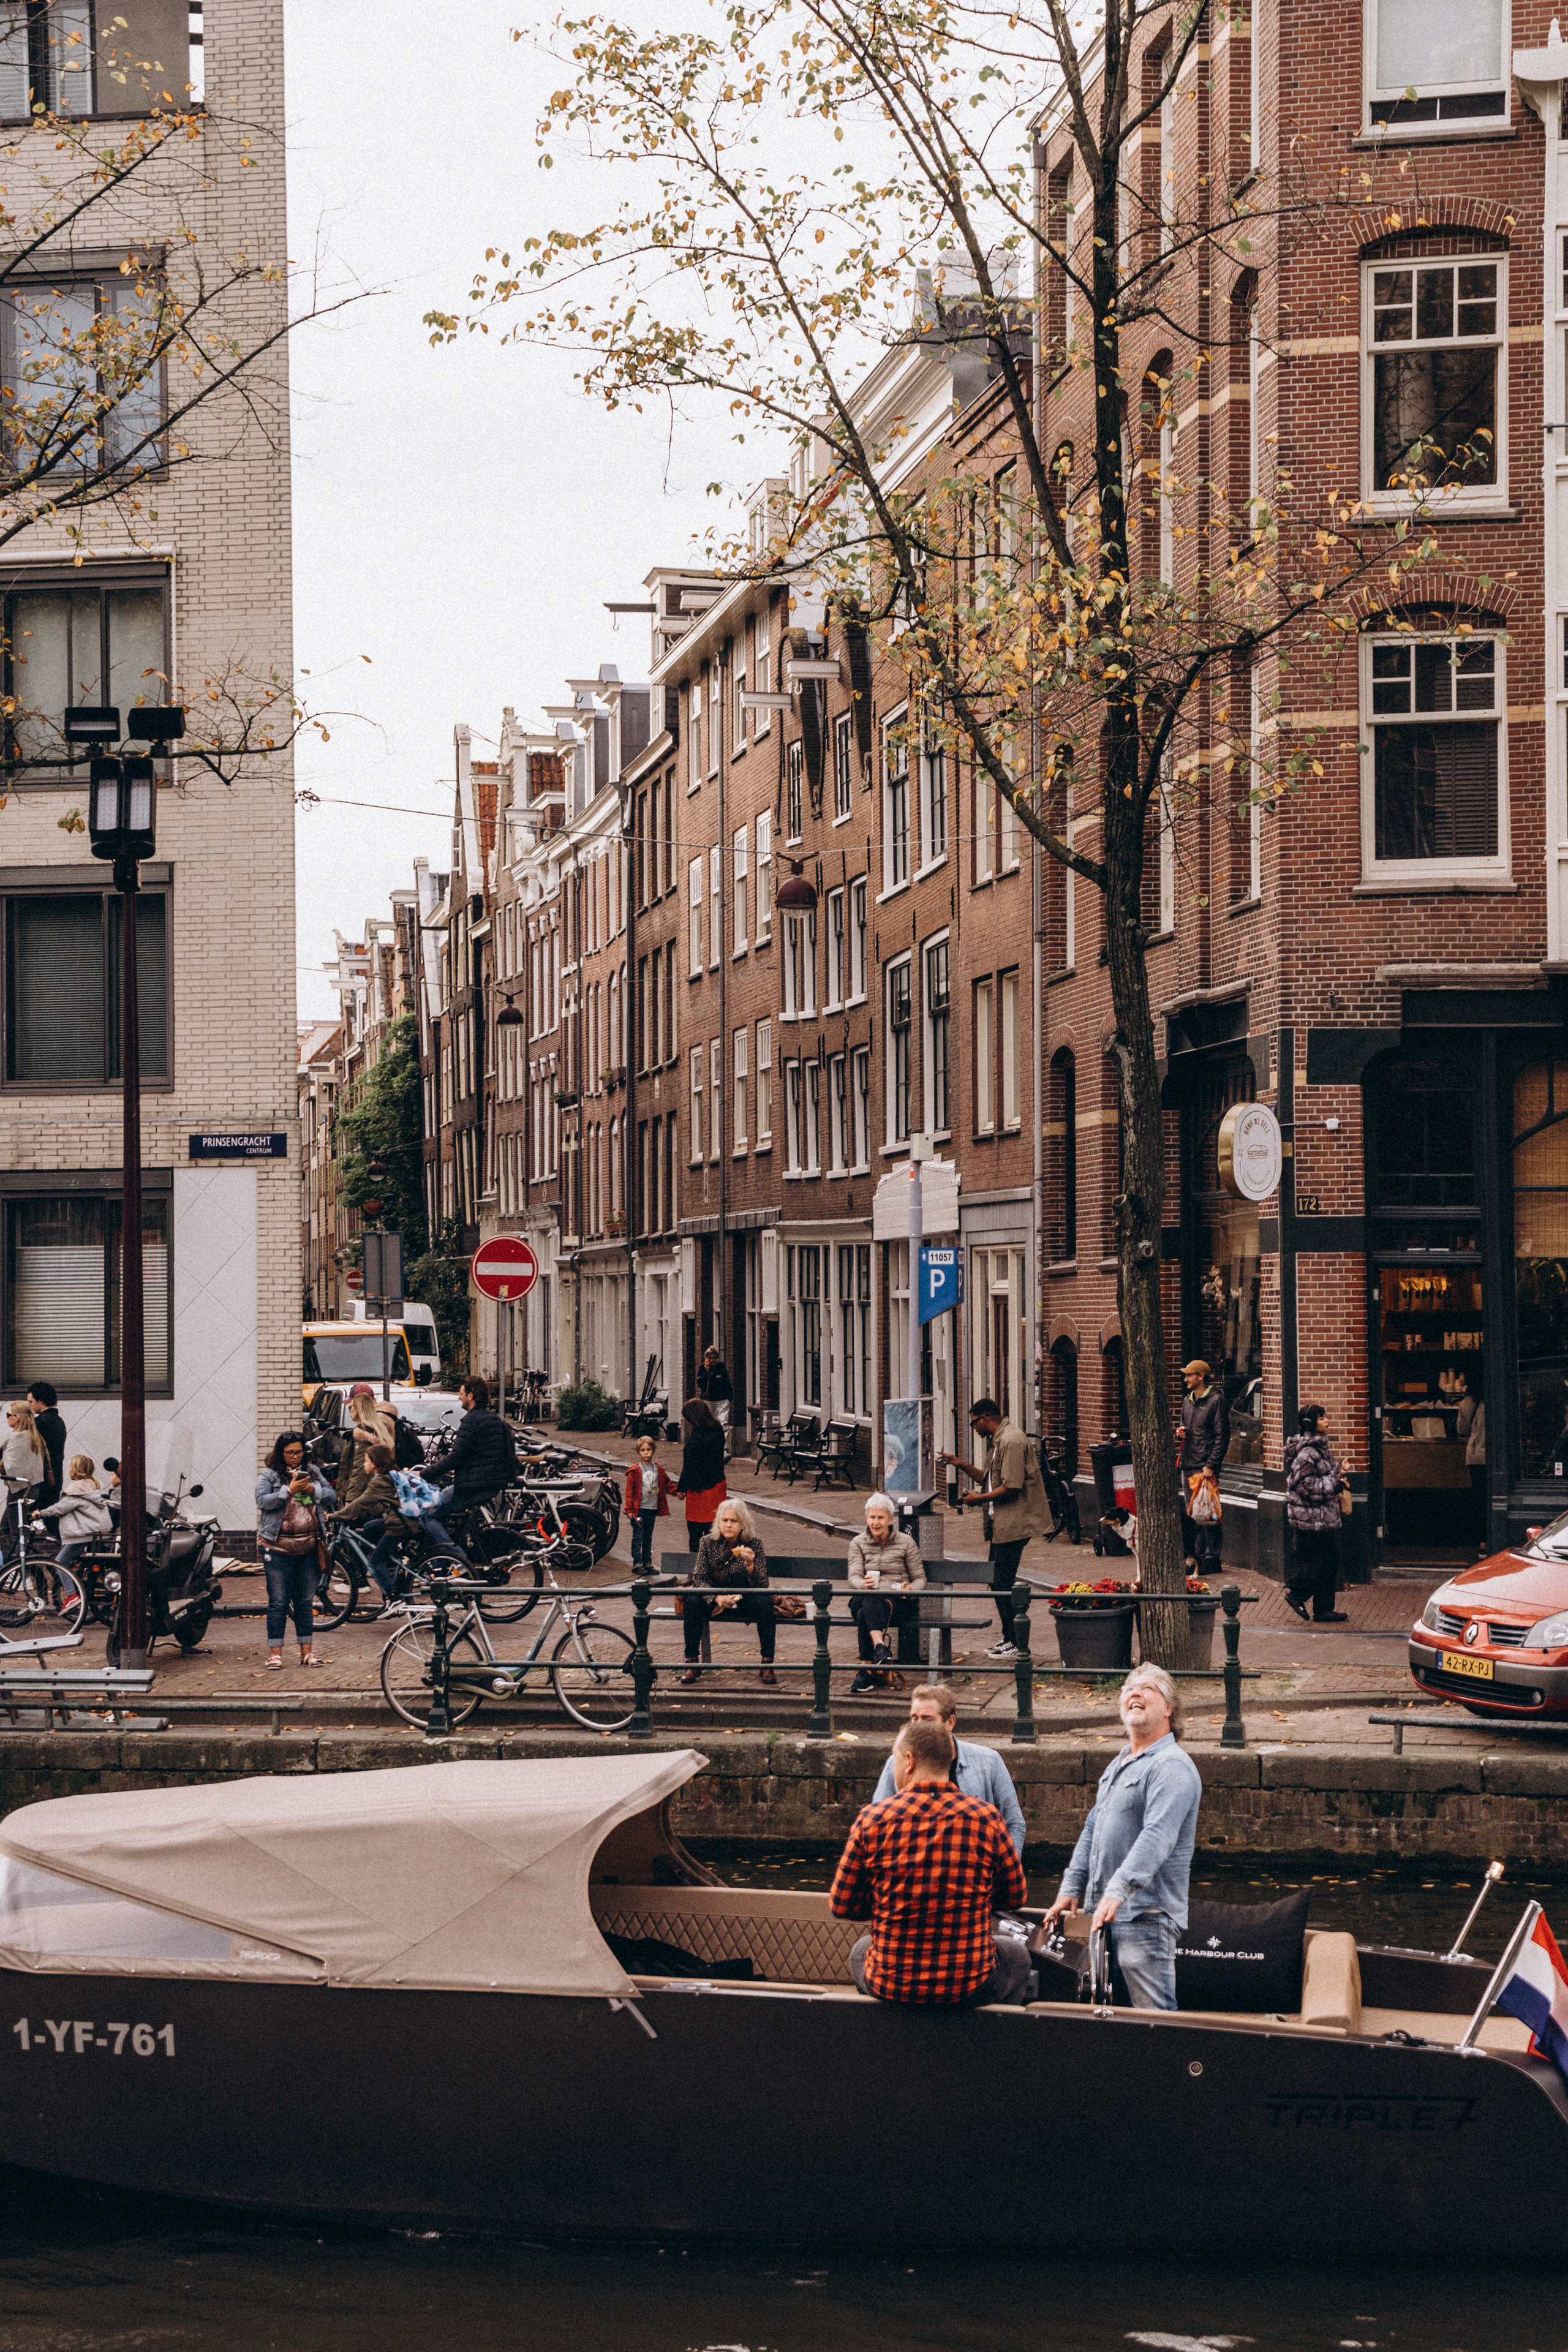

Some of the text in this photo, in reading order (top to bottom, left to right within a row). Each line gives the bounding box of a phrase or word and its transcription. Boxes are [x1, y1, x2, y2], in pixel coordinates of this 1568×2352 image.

[202, 1136, 271, 1147] PRINSENGRACHT
[1298, 1197, 1316, 1211] 172
[930, 1253, 952, 1262] 11057
[930, 1268, 946, 1298] P
[1446, 1656, 1489, 1676] 42-RX-PJ
[12, 2017, 175, 2057] 1-YF-761
